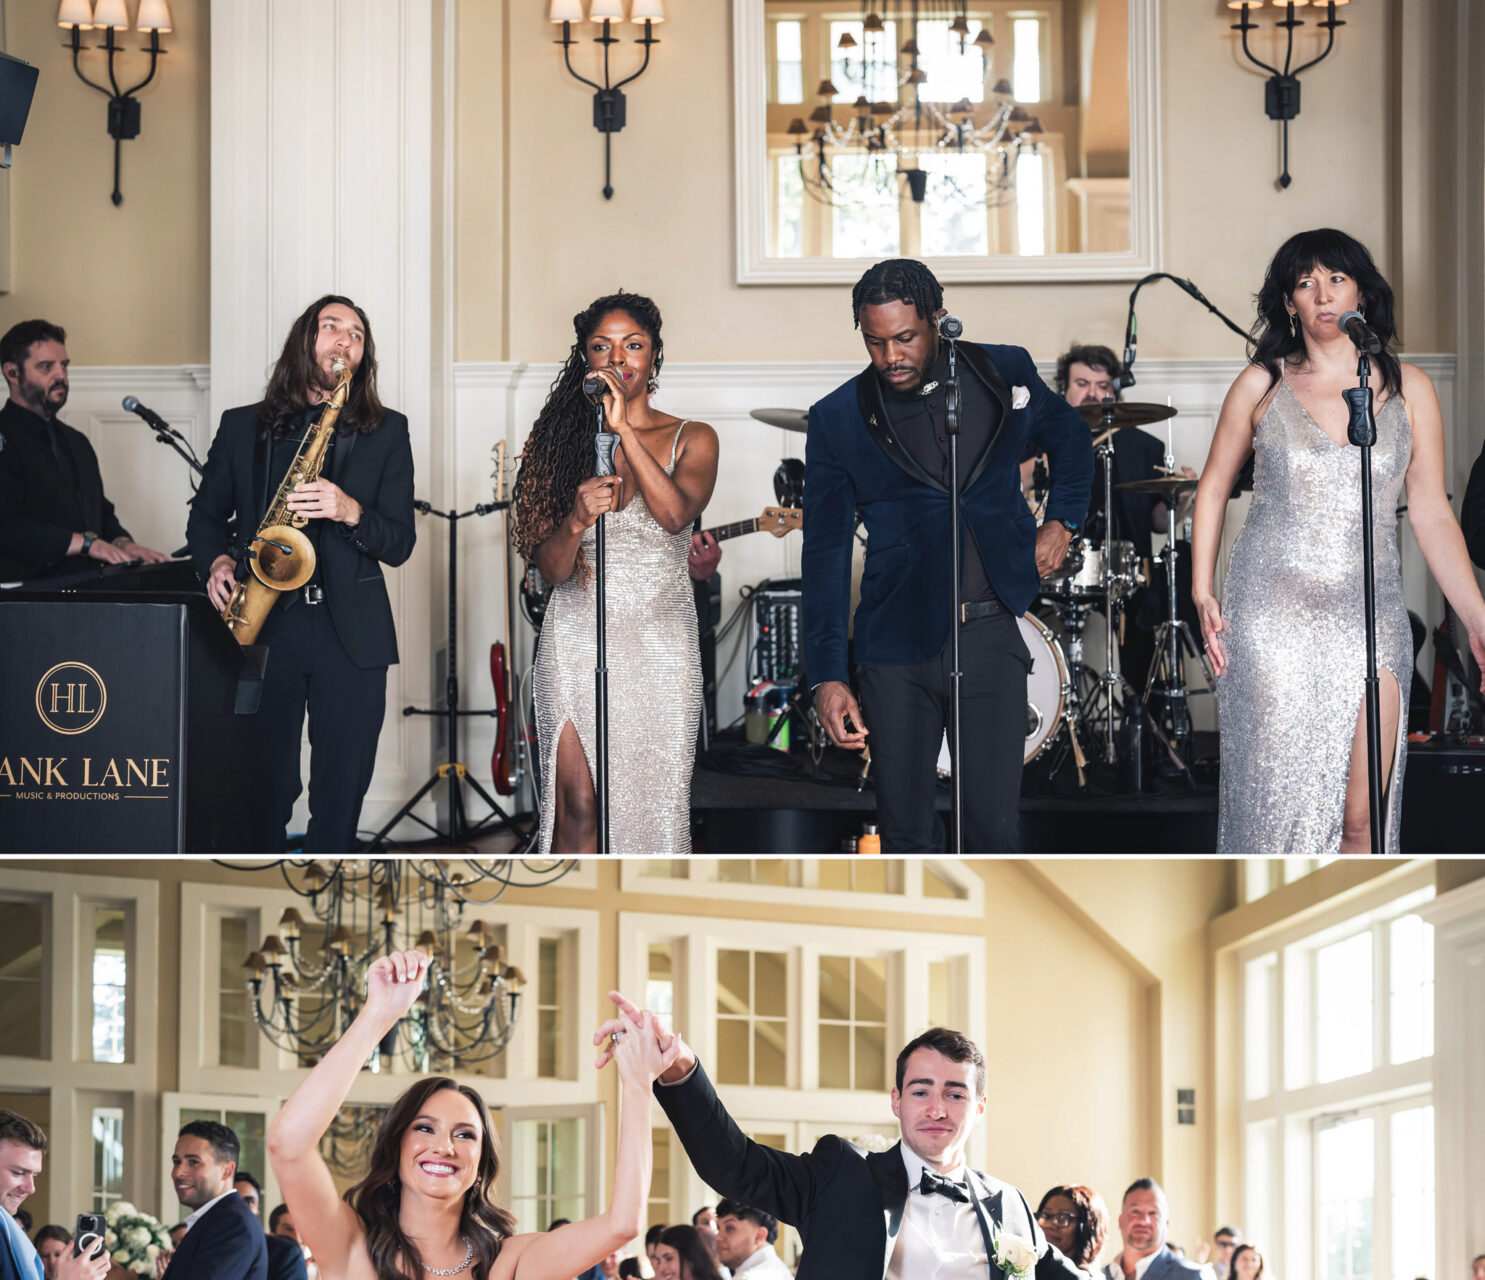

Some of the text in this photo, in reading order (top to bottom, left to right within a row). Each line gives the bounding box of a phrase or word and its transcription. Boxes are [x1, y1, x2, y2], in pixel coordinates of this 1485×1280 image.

[50, 683, 95, 713] HL
[82, 758, 170, 787] LANE
[16, 792, 120, 801] MUSIC & PRODUCTIONS
